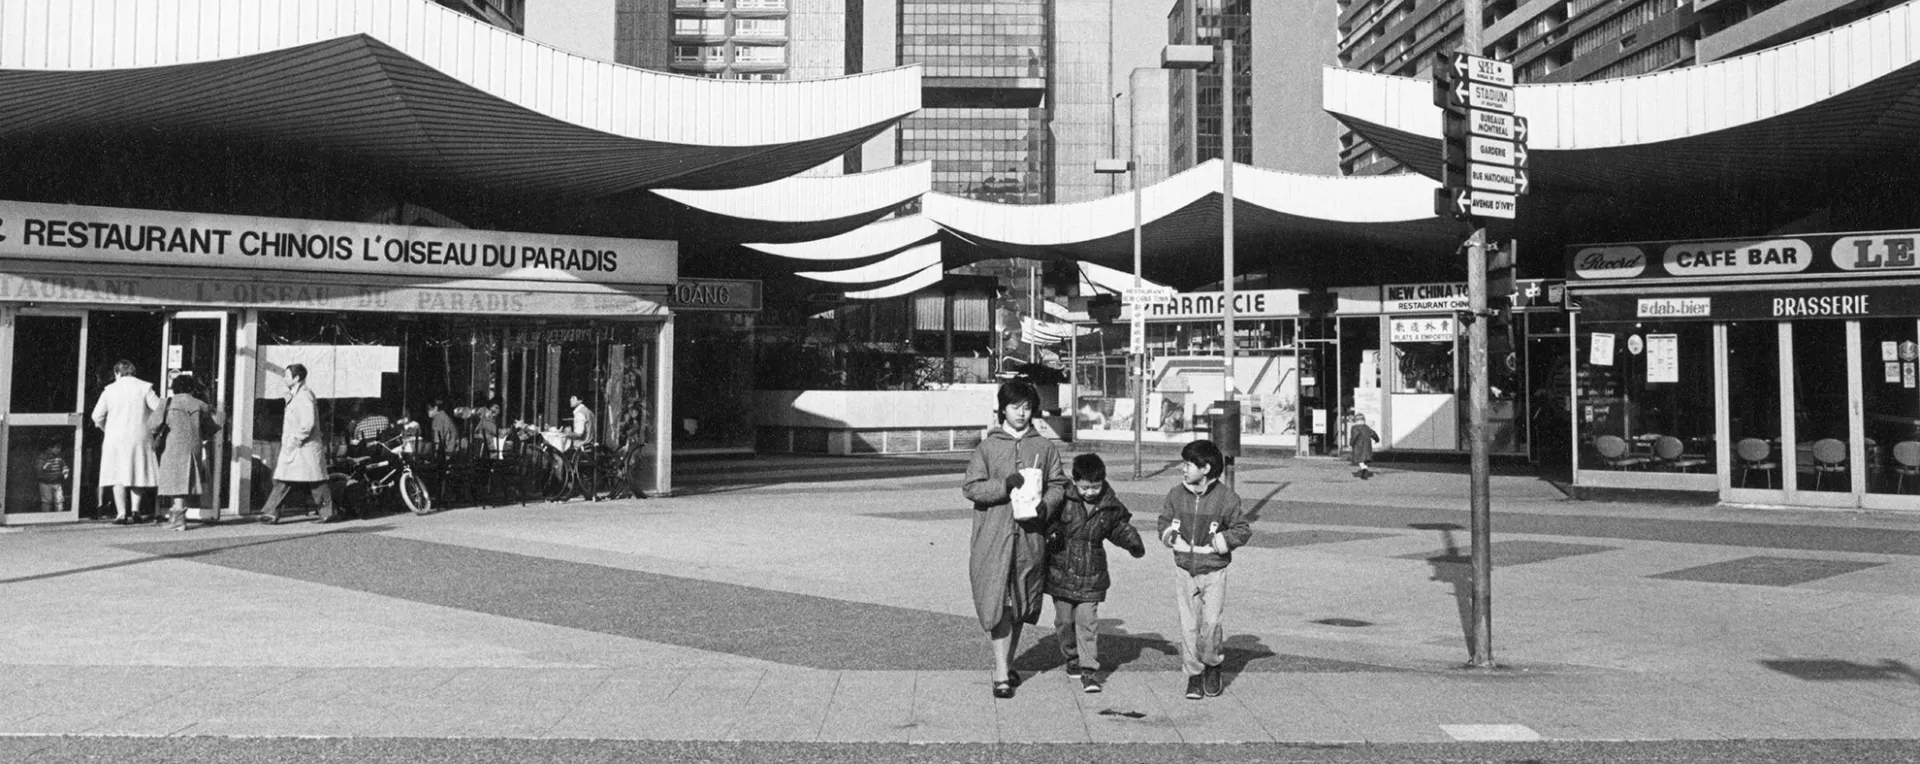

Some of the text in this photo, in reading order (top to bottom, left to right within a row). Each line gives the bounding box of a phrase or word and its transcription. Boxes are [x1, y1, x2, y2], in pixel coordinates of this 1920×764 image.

[1476, 86, 1508, 103] STADIUM
[1480, 113, 1505, 126] BUREAUX
[1478, 123, 1508, 136] MONTREAL
[1480, 144, 1506, 157] GARDERIE
[1472, 171, 1514, 184] RUE NATIONALE
[1472, 199, 1514, 211] AVENUE D'IVRY
[24, 218, 232, 255] RESTAURANT
[239, 231, 353, 260] CHINOIS
[363, 234, 477, 267] L'OISEAU
[483, 244, 516, 269] DU
[522, 246, 617, 272] PARADIS
[1853, 238, 1915, 268] LE
[1676, 247, 1797, 268] CAFE BAR
[1388, 284, 1470, 301] NEW CHINA TO
[418, 291, 524, 312] PARADIS
[1144, 294, 1265, 315] HARMACIE
[1398, 302, 1448, 310] RESTAURANT
[1649, 300, 1709, 315] dab-bier
[1773, 294, 1869, 317] BRASSERIE
